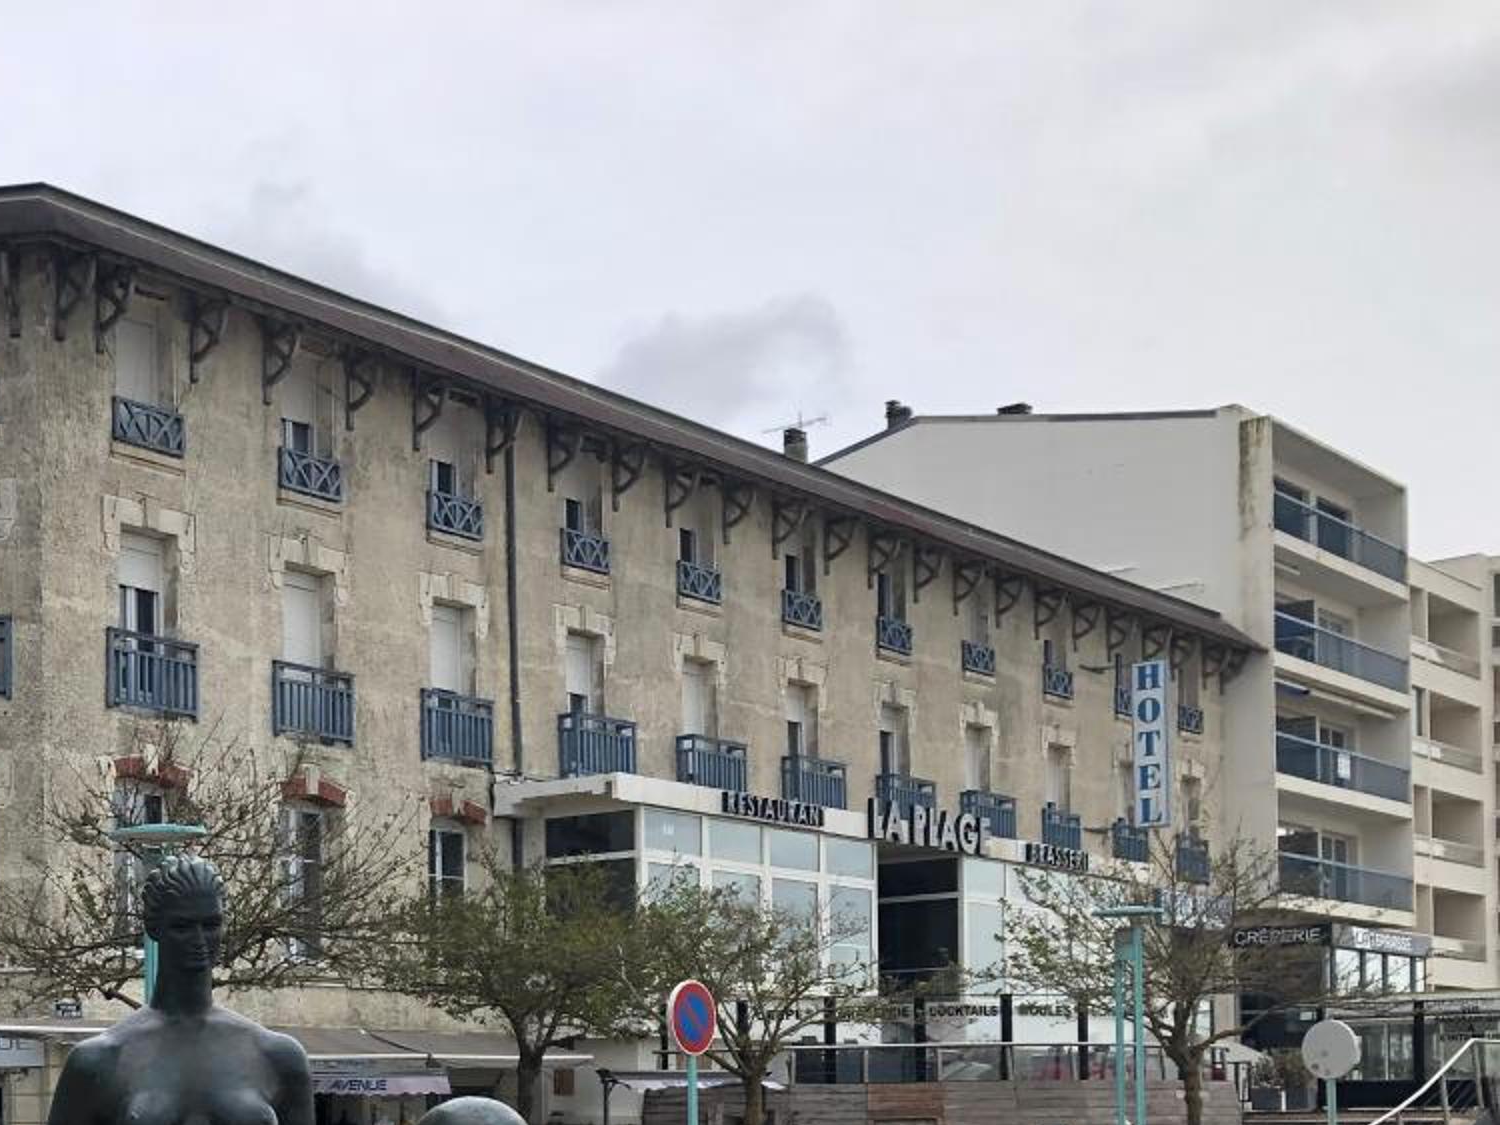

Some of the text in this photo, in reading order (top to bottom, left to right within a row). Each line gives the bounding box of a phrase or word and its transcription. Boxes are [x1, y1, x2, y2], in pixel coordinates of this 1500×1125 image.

[1137, 664, 1163, 823] HOTEL
[868, 797, 990, 856] LA PLAGE
[330, 1079, 388, 1091] AVENUE
